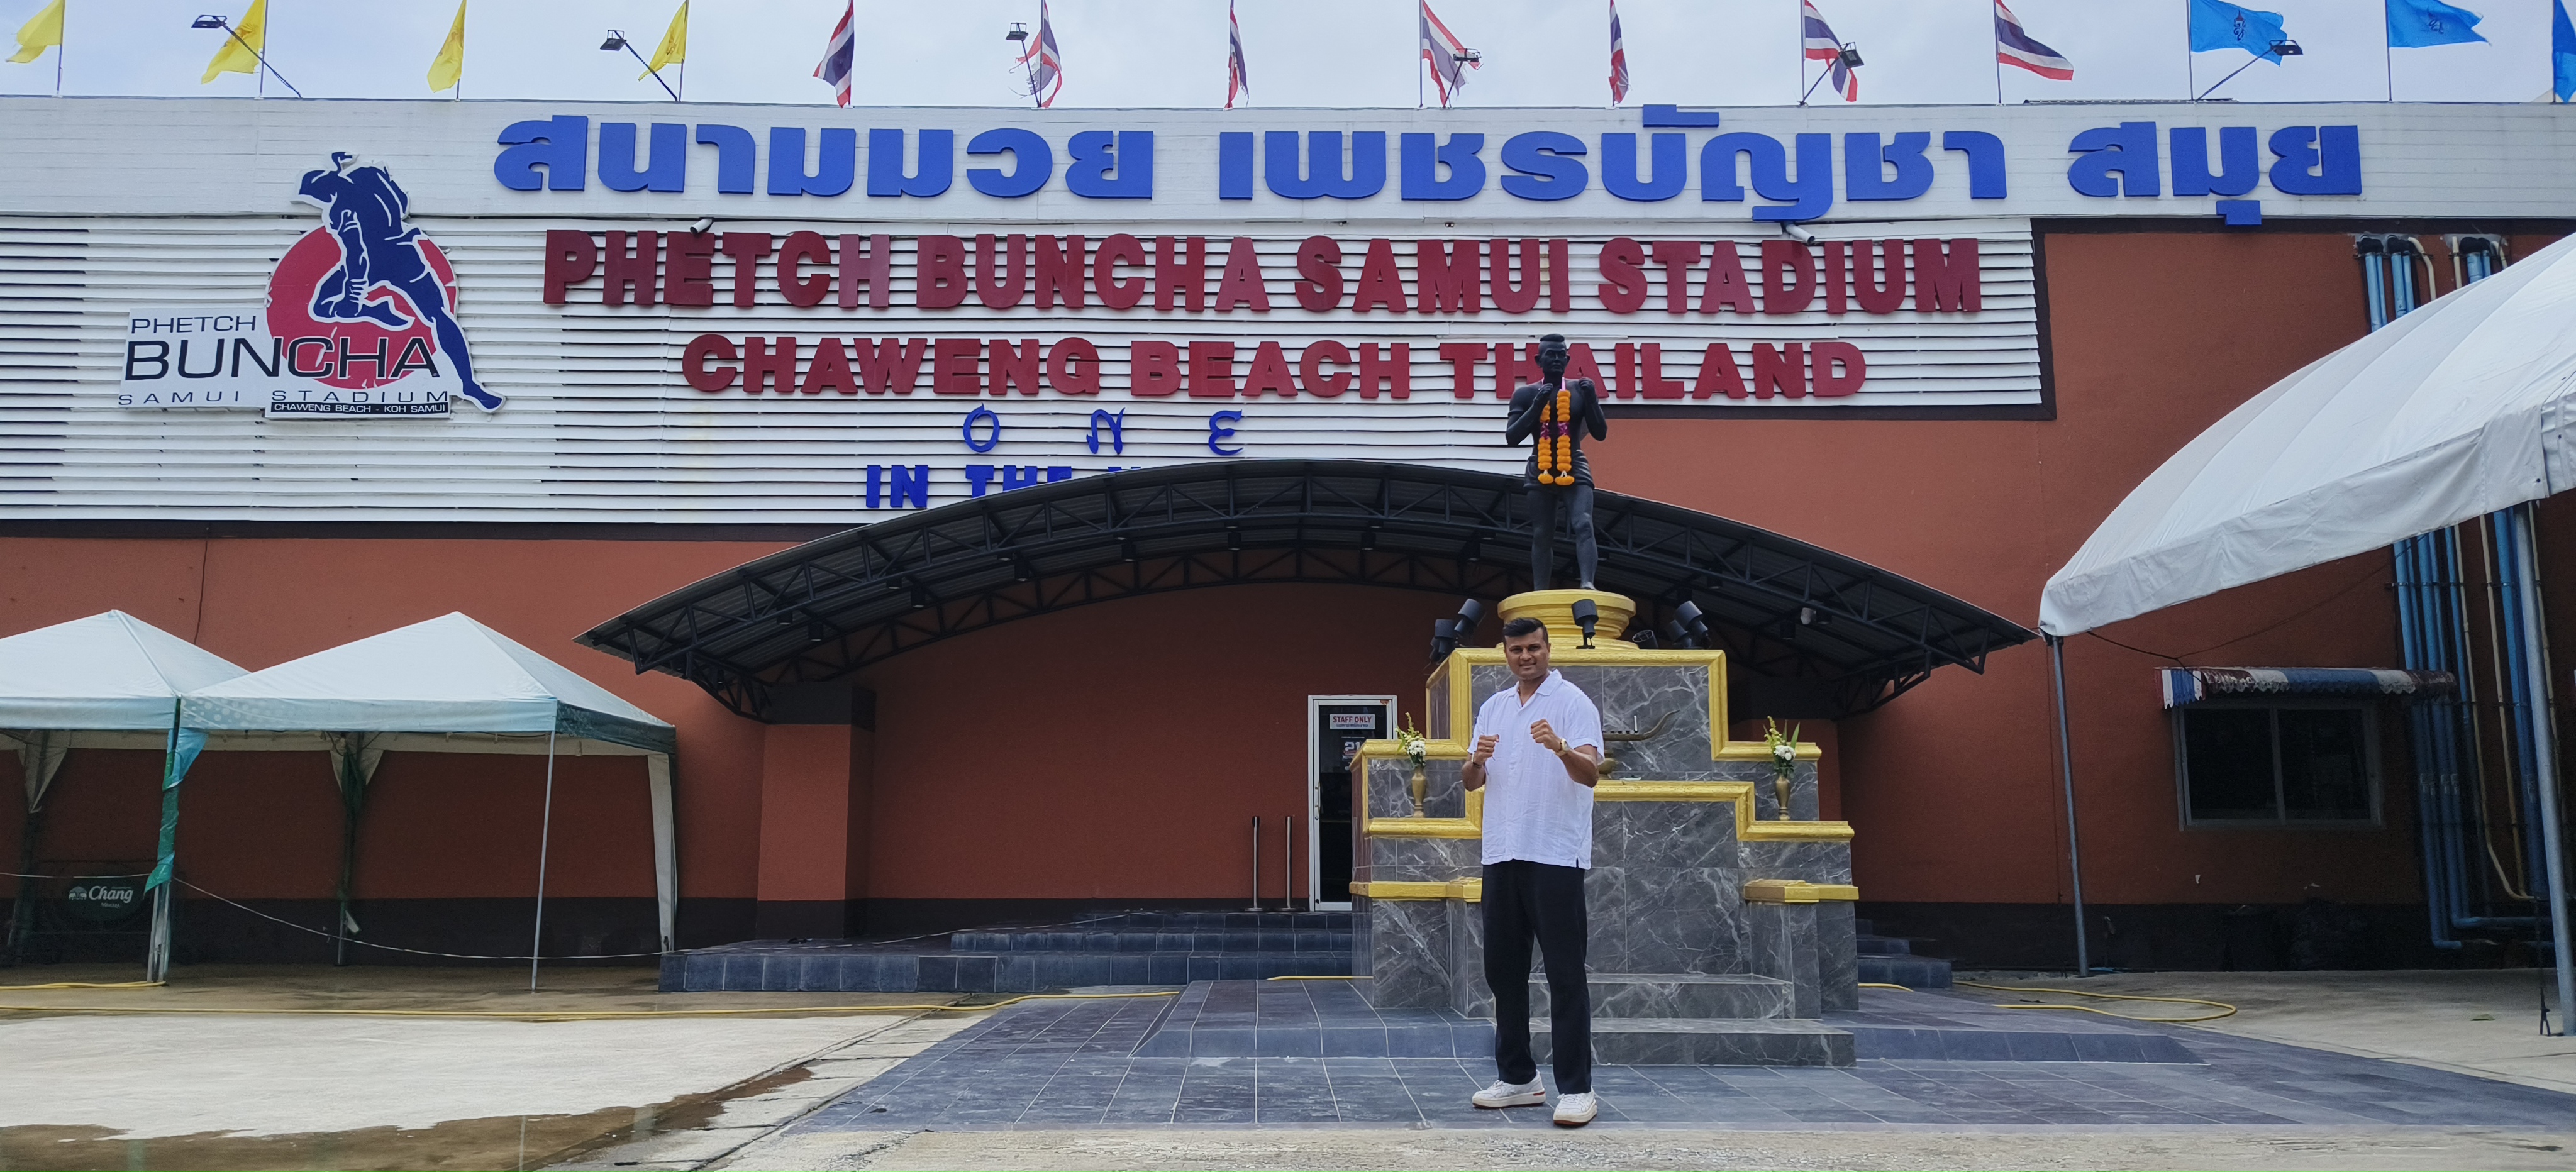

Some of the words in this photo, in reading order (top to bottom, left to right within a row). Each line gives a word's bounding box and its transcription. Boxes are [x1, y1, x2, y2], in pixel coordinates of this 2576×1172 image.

[494, 115, 1153, 199] สนามมวย
[1219, 104, 2007, 221] เพชรบัญชา
[2068, 121, 2362, 226] สมุย
[544, 230, 890, 308] PHETCH
[916, 235, 1270, 310] BUNCHA
[1295, 236, 1570, 314] SAMUI
[1598, 238, 1981, 314] STADIUM
[131, 316, 256, 334] PHETCH
[125, 338, 440, 380] BUNCHA
[682, 334, 1100, 395] CHAWENG
[1130, 340, 1411, 399] BEACH
[1439, 341, 1867, 399] THAILAND
[118, 391, 239, 406] SAMUI
[272, 390, 448, 402] STADIUM
[274, 404, 331, 412] CHAWENG
[335, 404, 371, 413] BEACH
[384, 405, 406, 413] KOH
[411, 404, 445, 414] SAMUI
[865, 465, 930, 509] IN
[89, 885, 133, 903] Chang
